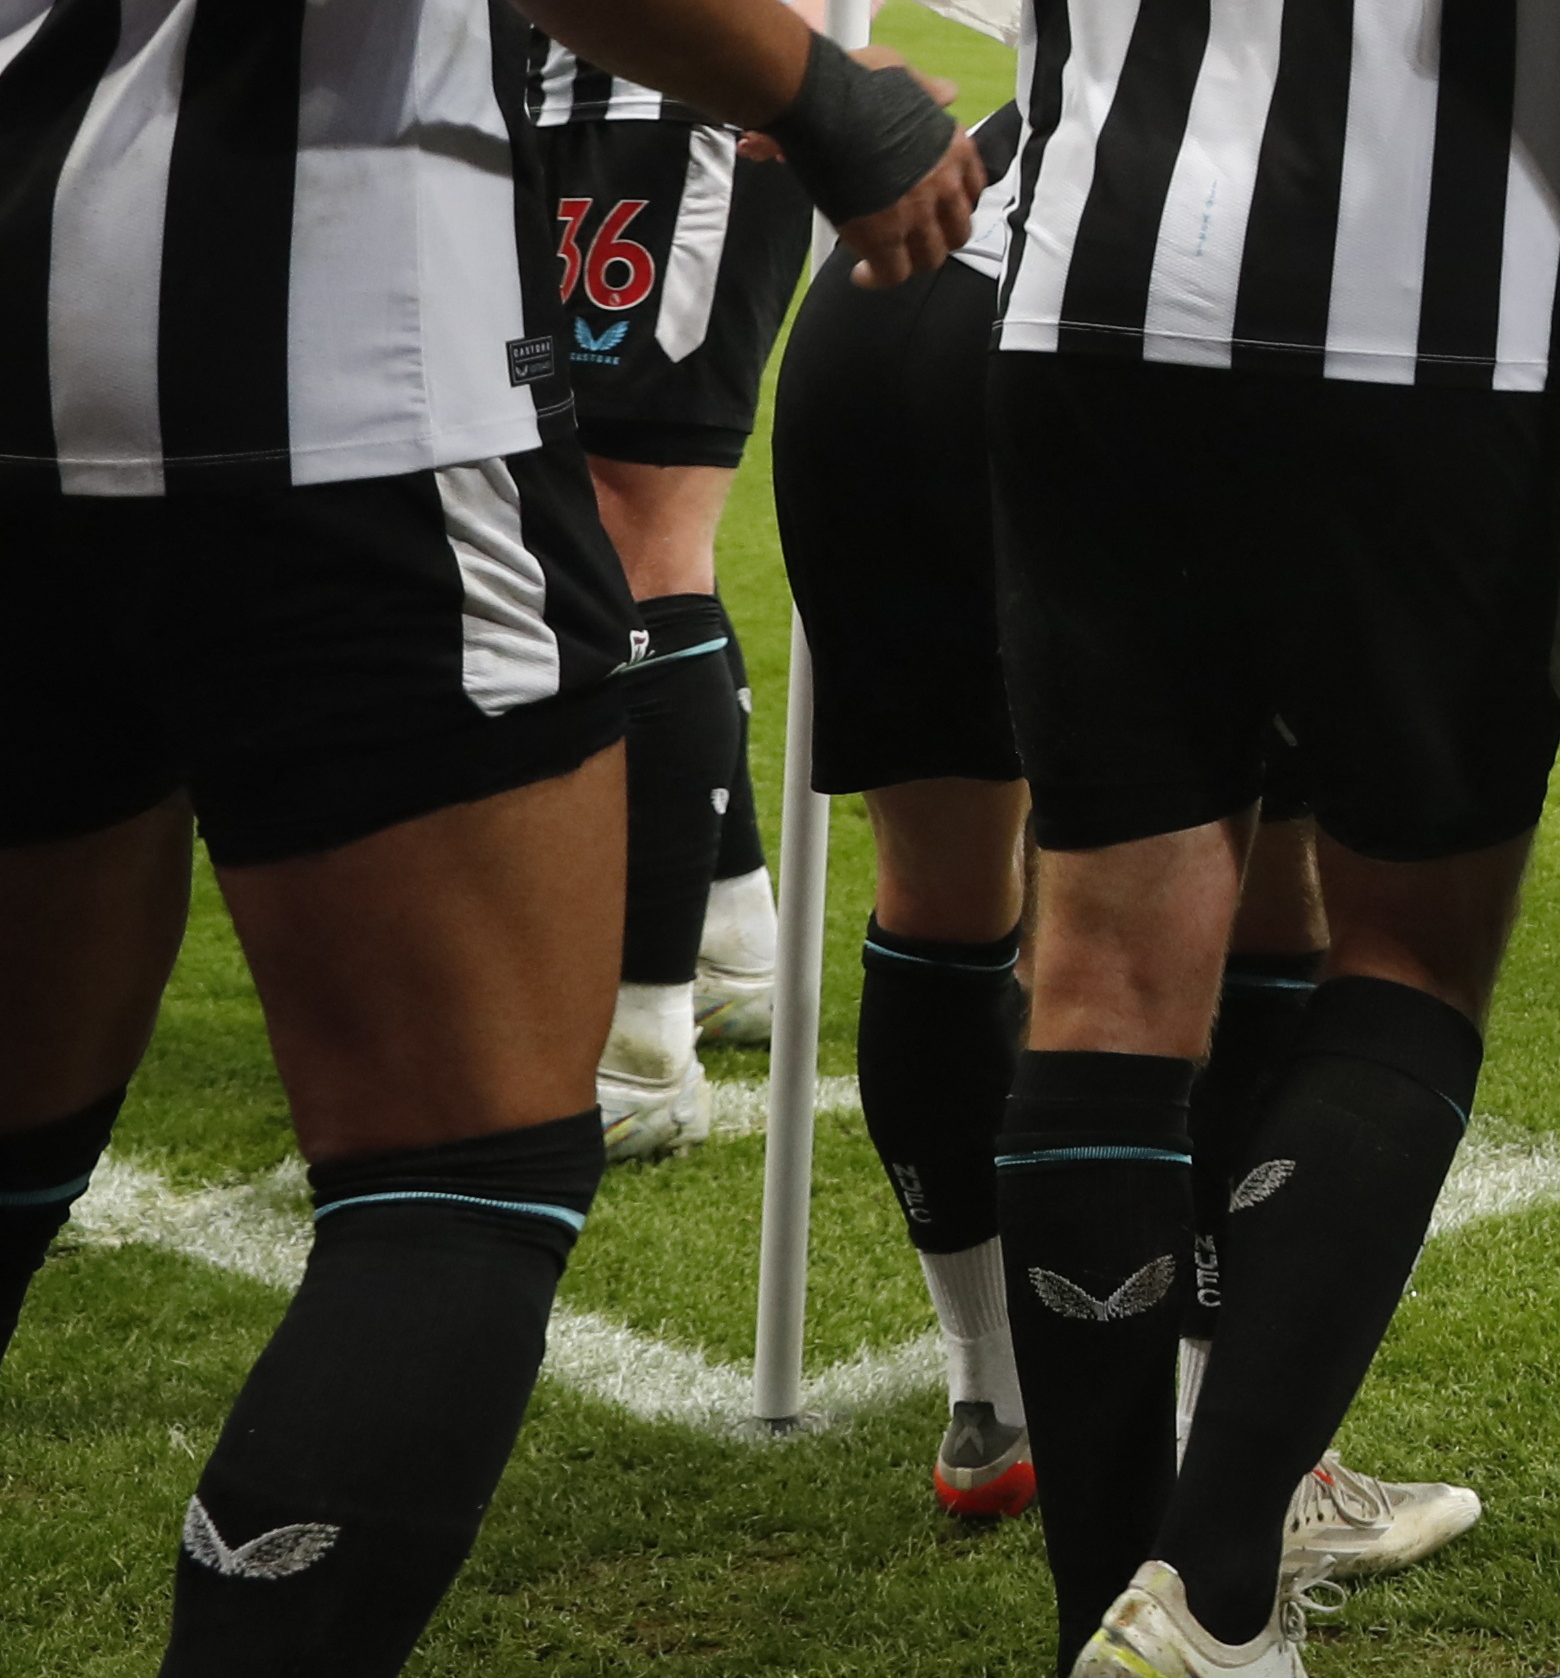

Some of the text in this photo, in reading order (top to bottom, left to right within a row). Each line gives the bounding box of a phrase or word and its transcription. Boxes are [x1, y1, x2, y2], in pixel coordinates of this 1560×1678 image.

[556, 197, 656, 311] 36
[513, 341, 551, 358] CASTORE
[569, 351, 621, 366] CASTORE
[892, 1162, 932, 1223] NUFC
[1194, 1234, 1221, 1307] NUFC
